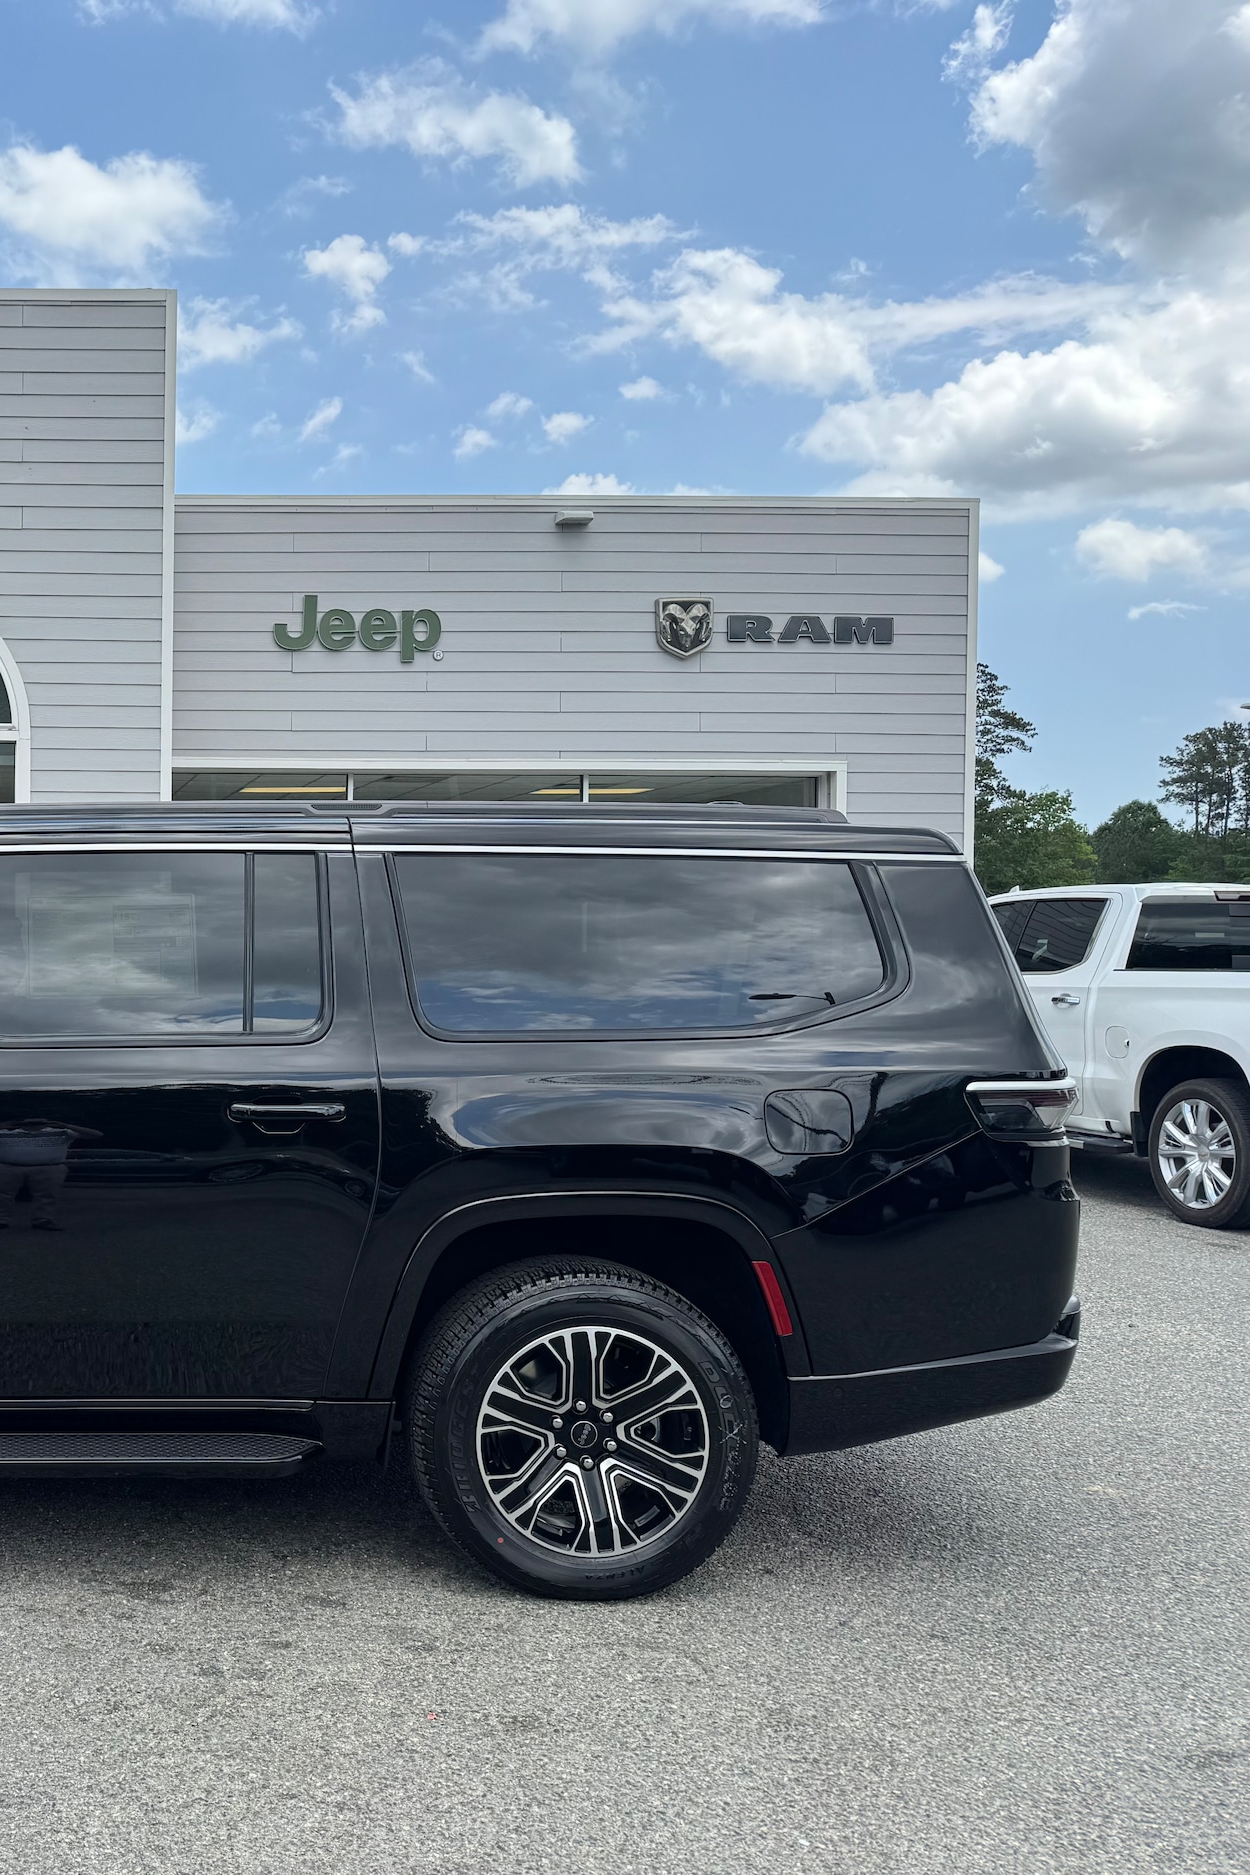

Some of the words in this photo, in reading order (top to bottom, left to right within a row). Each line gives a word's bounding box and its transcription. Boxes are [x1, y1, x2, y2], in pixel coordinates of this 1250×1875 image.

[273, 594, 442, 663] Jeep
[726, 614, 894, 645] RAM
[583, 1564, 645, 1582] ALENZA
